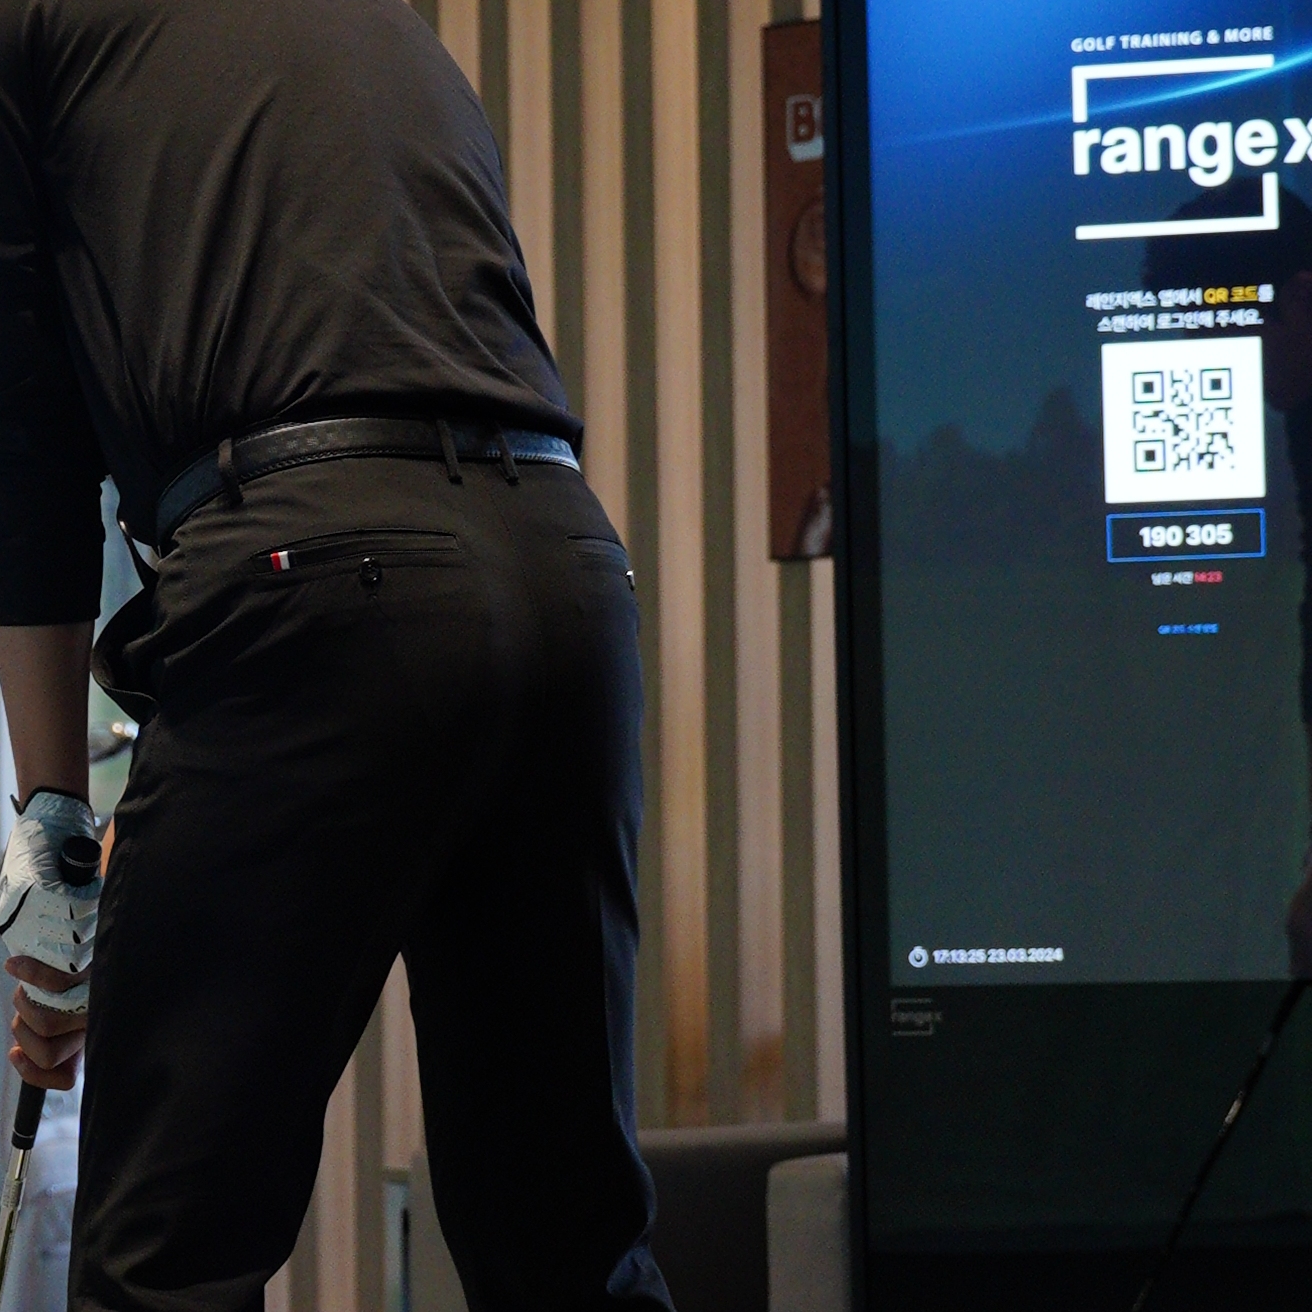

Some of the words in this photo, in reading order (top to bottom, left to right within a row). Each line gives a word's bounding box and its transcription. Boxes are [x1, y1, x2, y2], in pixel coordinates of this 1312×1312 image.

[1071, 36, 1116, 53] GOLF
[1120, 30, 1203, 49] TRAINING
[1206, 29, 1221, 44] &
[1224, 25, 1275, 43] MORE
[1204, 287, 1229, 305] QR
[1139, 525, 1184, 547] 190
[1185, 523, 1234, 546] 305
